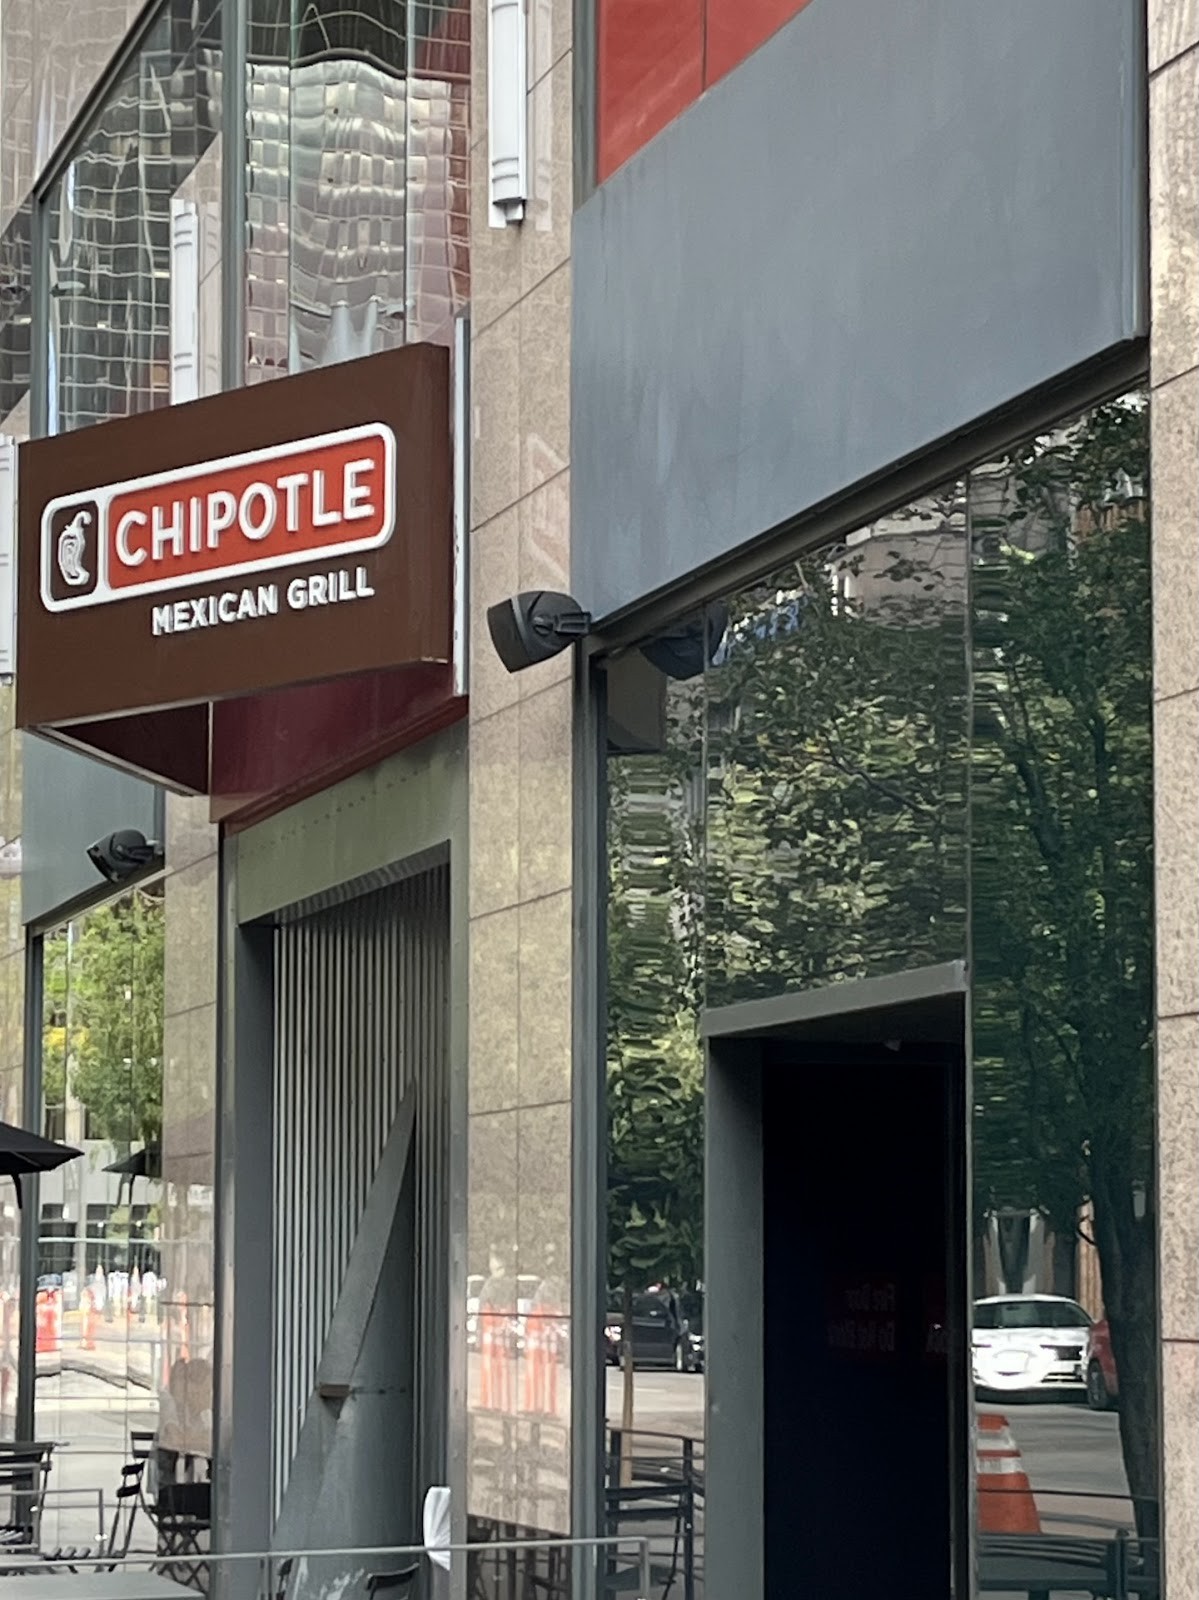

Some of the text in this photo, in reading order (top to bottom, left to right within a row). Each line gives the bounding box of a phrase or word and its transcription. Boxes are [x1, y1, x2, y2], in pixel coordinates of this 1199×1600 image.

[116, 458, 375, 566] CHIPOTLE
[152, 567, 375, 636] MEXICAN GRILL
